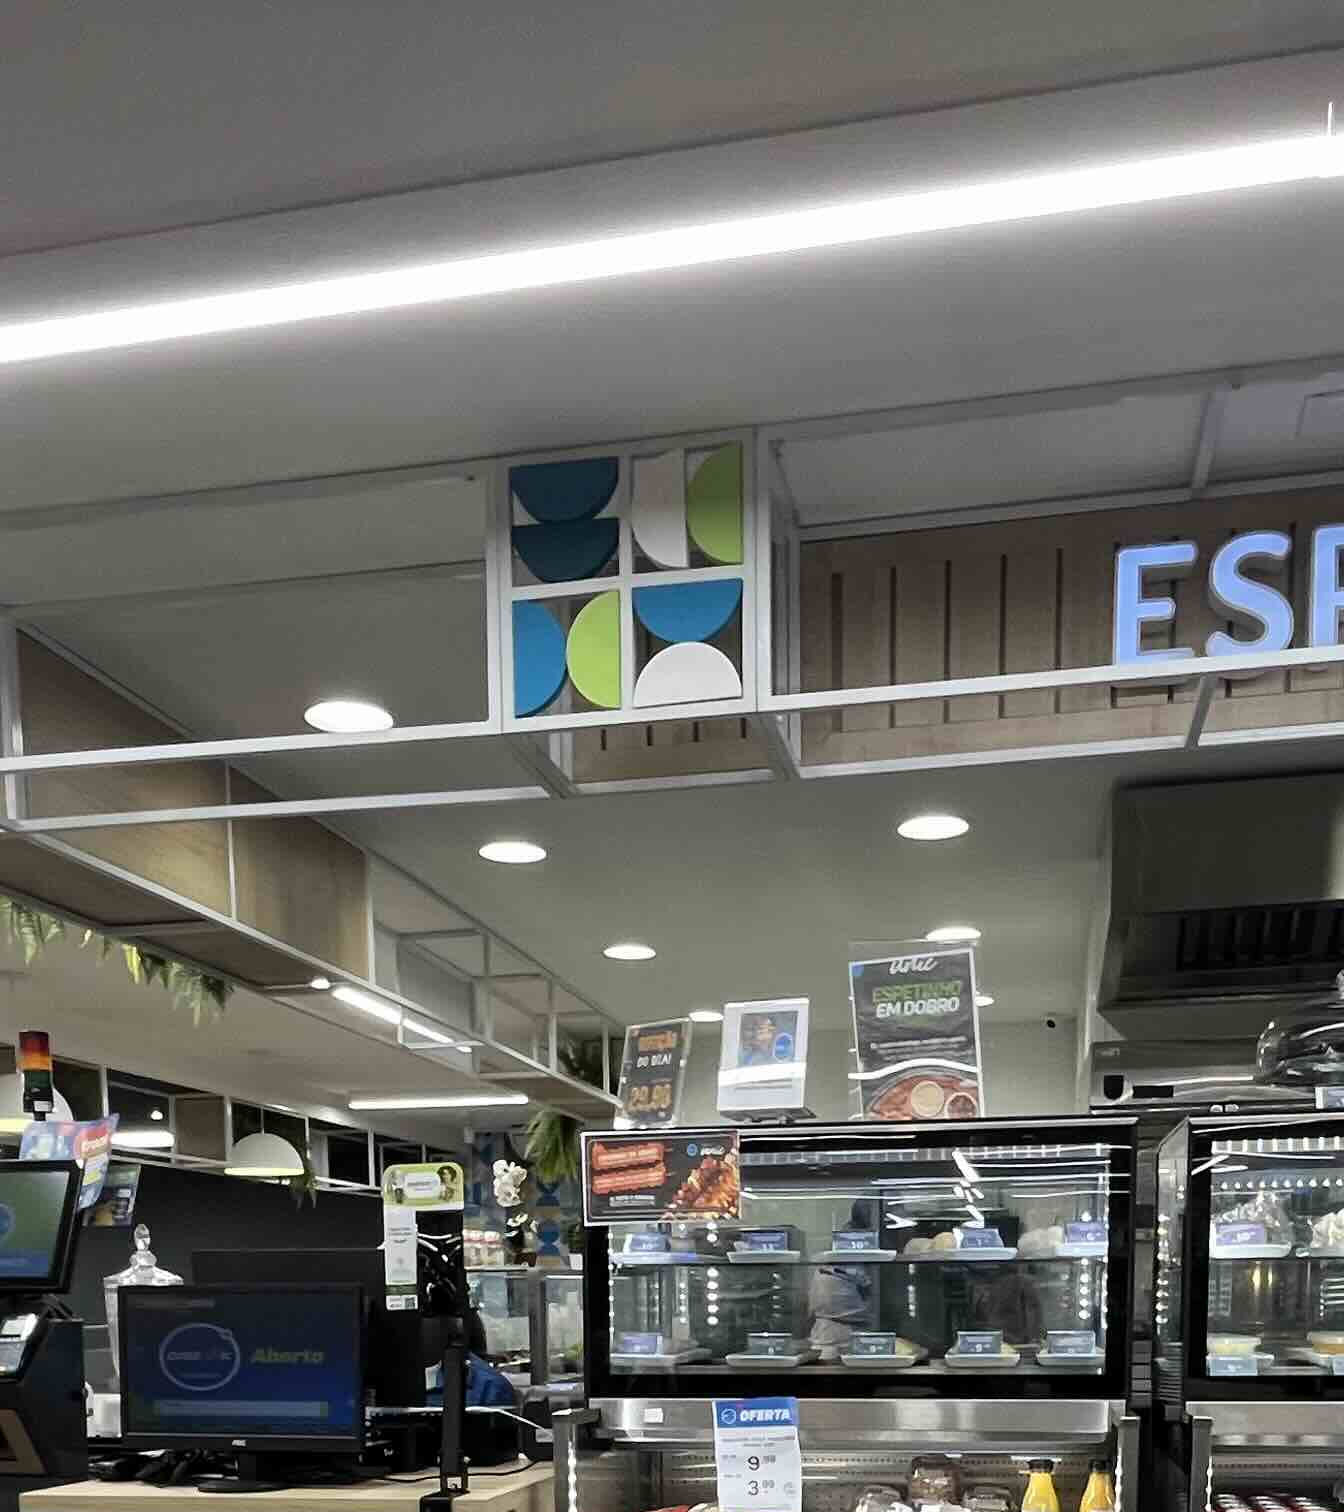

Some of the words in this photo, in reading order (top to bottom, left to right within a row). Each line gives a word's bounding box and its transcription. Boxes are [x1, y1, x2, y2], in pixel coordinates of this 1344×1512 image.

[875, 1000, 901, 1018] EM
[903, 996, 960, 1016] DOBRO
[739, 1408, 791, 1422] OFERTA
[747, 1455, 760, 1471] 9
[747, 1480, 759, 1496] 3
